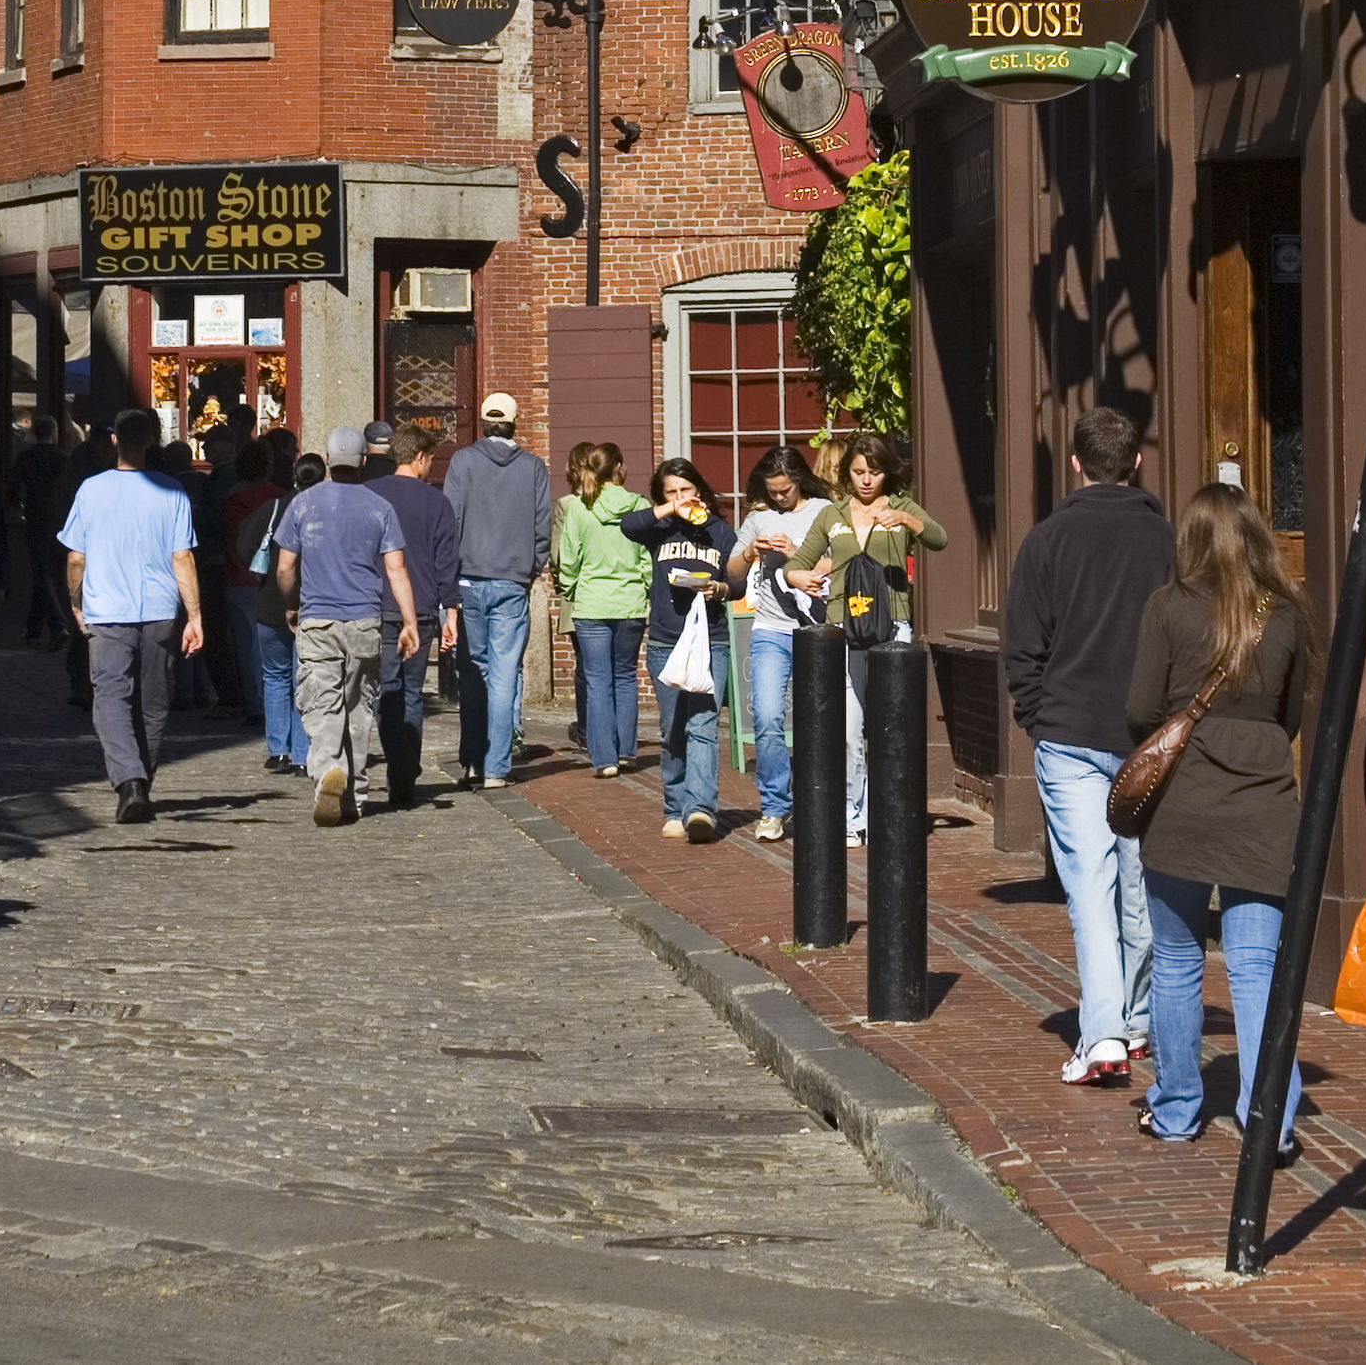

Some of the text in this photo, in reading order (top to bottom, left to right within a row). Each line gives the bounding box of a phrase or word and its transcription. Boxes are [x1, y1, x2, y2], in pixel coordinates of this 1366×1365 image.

[968, 2, 1083, 37] HOUSE
[743, 36, 785, 67] GREEN
[989, 50, 1070, 72] est.1826
[781, 132, 850, 161] TAERN
[88, 172, 332, 230] Boston Stone
[100, 223, 321, 250] GIFT SHOP
[96, 252, 325, 273] SOUVENIRS
